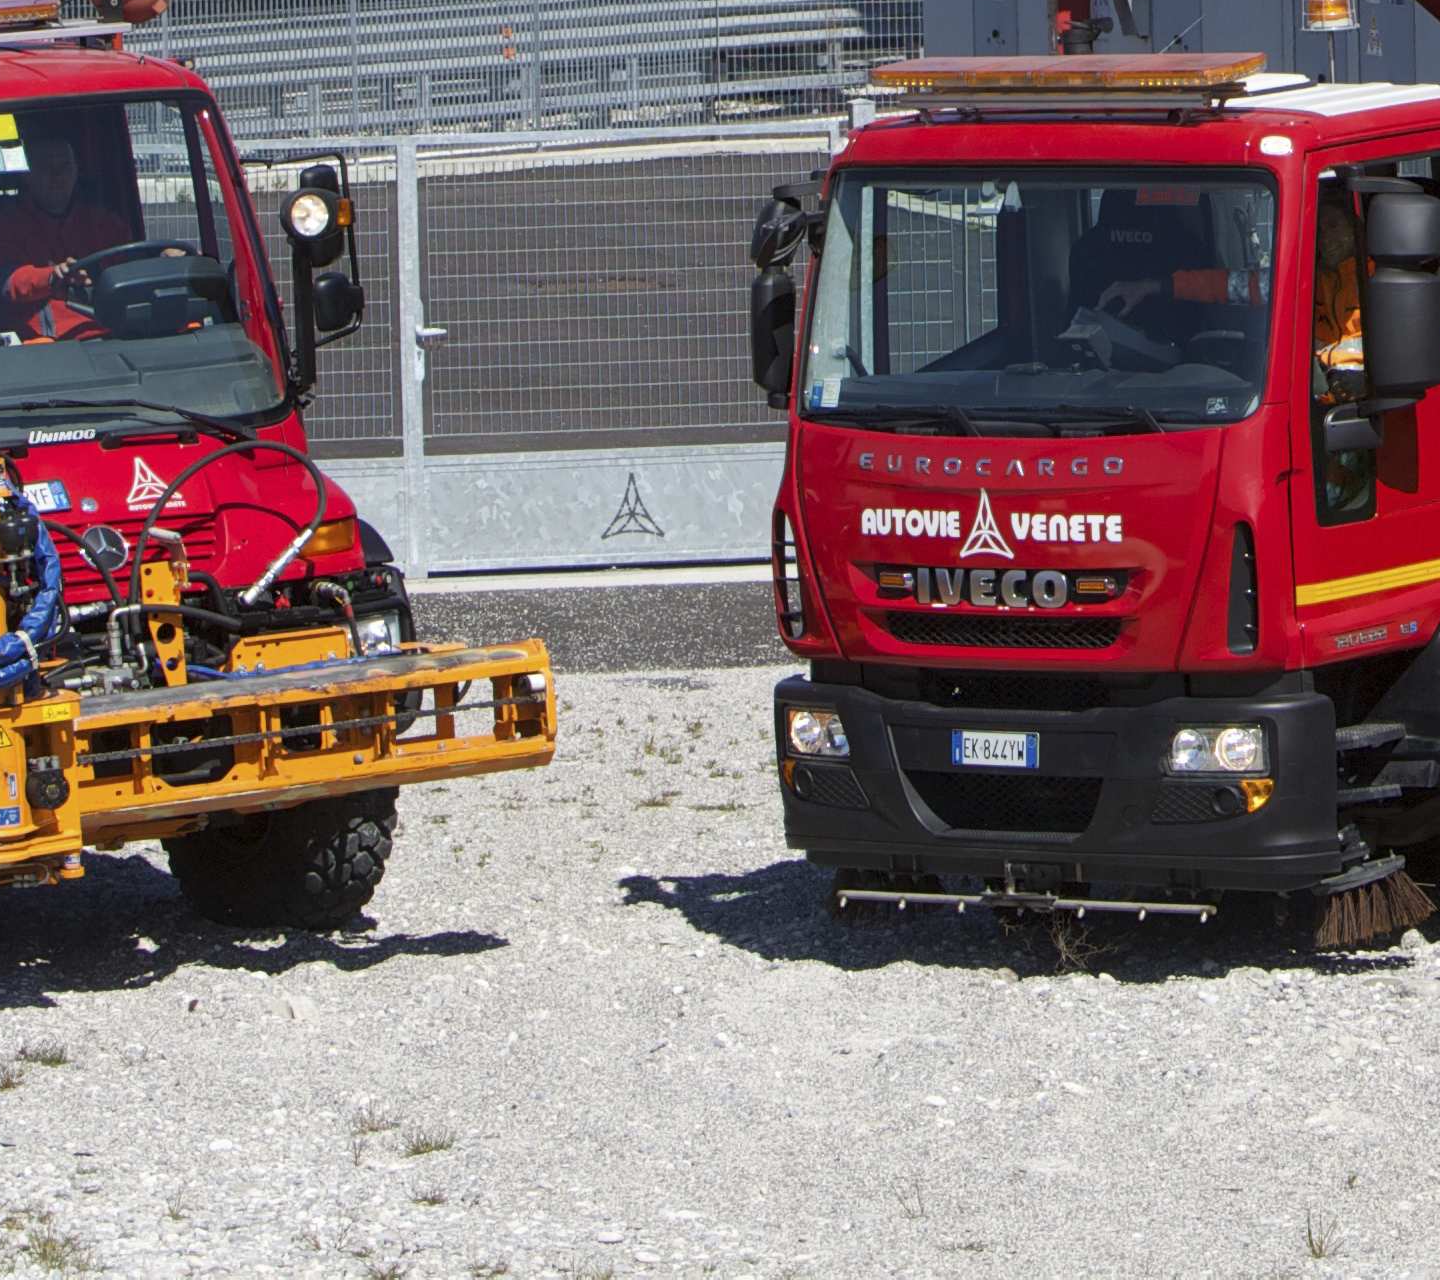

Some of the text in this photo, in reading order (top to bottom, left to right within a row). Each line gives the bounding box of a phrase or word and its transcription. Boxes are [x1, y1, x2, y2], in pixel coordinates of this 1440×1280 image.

[1110, 229, 1153, 243] IVECO
[28, 429, 97, 444] UNIMOG
[860, 452, 1124, 476] EUROCARGO
[861, 508, 1123, 542] AUTOVIE VENETE
[916, 568, 1068, 608] IVECO
[964, 738, 979, 760] EK
[983, 739, 1024, 761] 844YW
